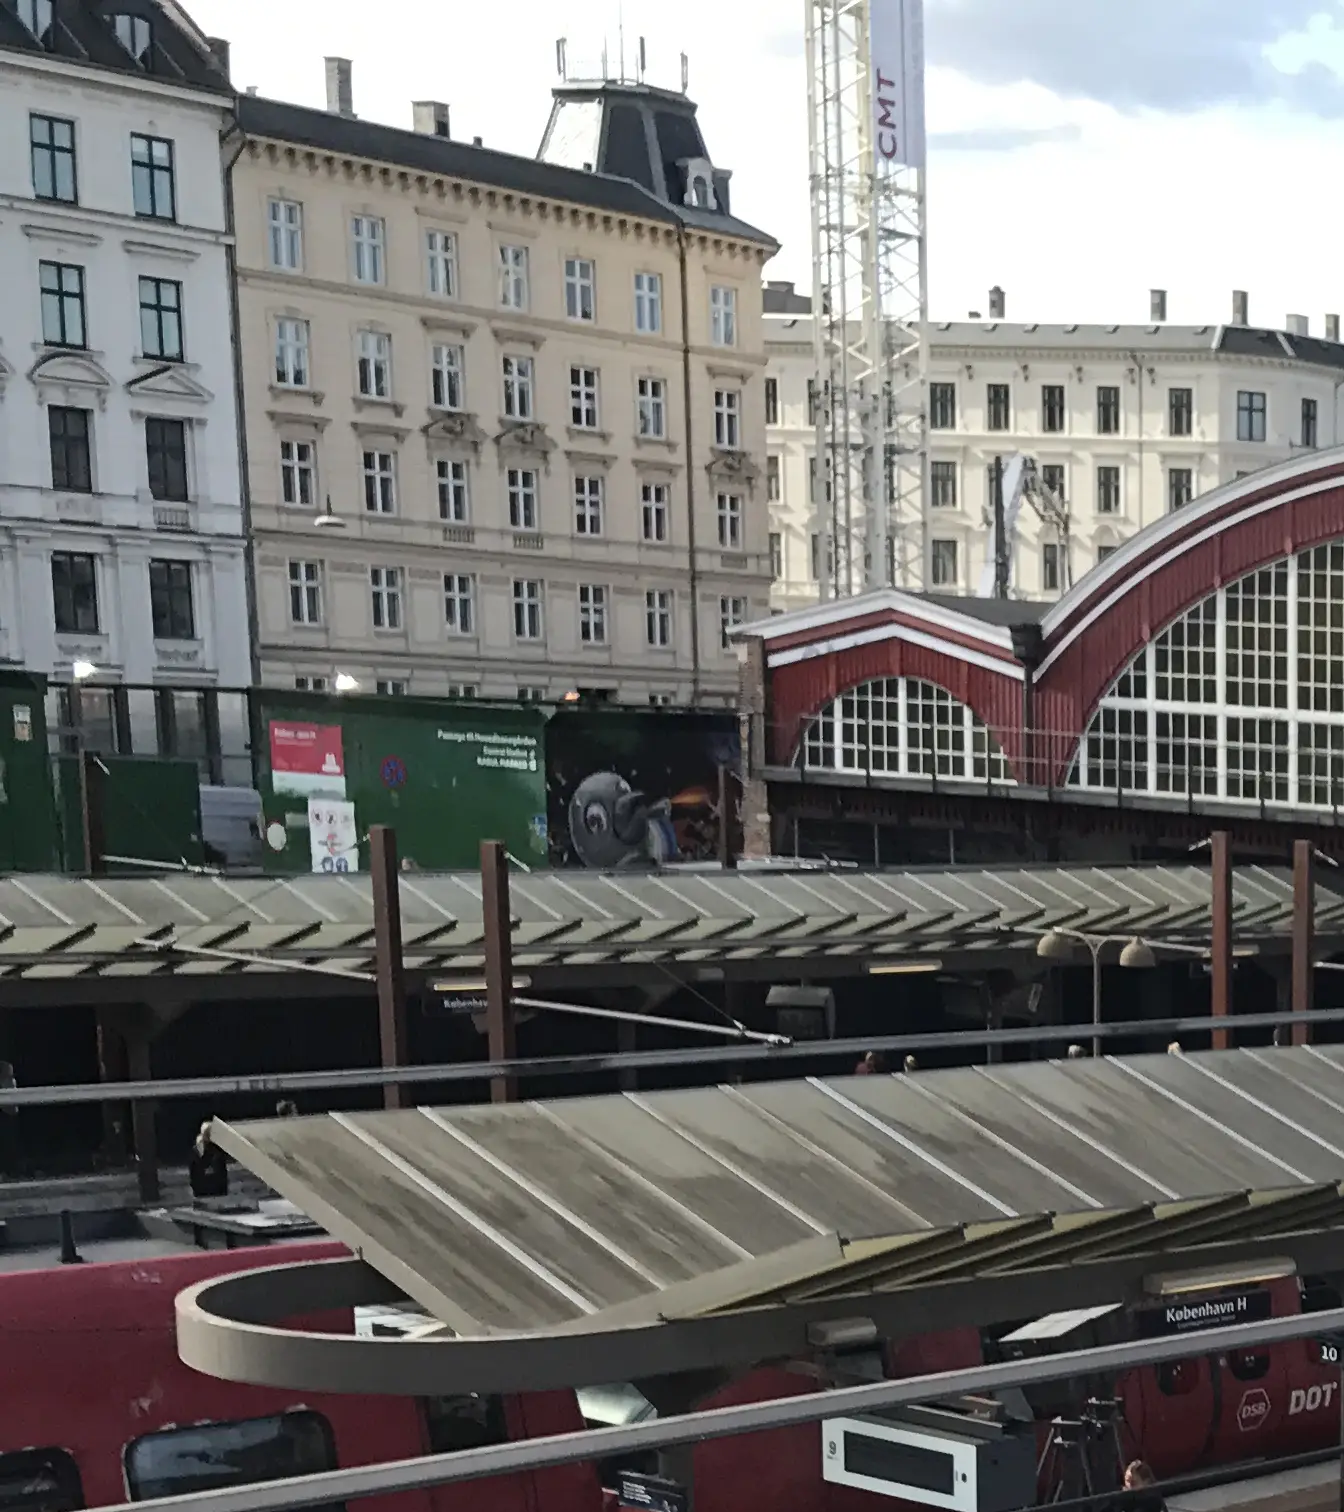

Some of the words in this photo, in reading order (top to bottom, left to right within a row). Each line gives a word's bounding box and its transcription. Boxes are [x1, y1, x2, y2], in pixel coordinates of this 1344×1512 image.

[876, 67, 897, 160] CMT
[1166, 1301, 1235, 1323] København
[1237, 1296, 1247, 1311] H
[1321, 1345, 1338, 1362] 10
[1241, 1401, 1266, 1419] DSB
[1288, 1382, 1338, 1416] DOT
